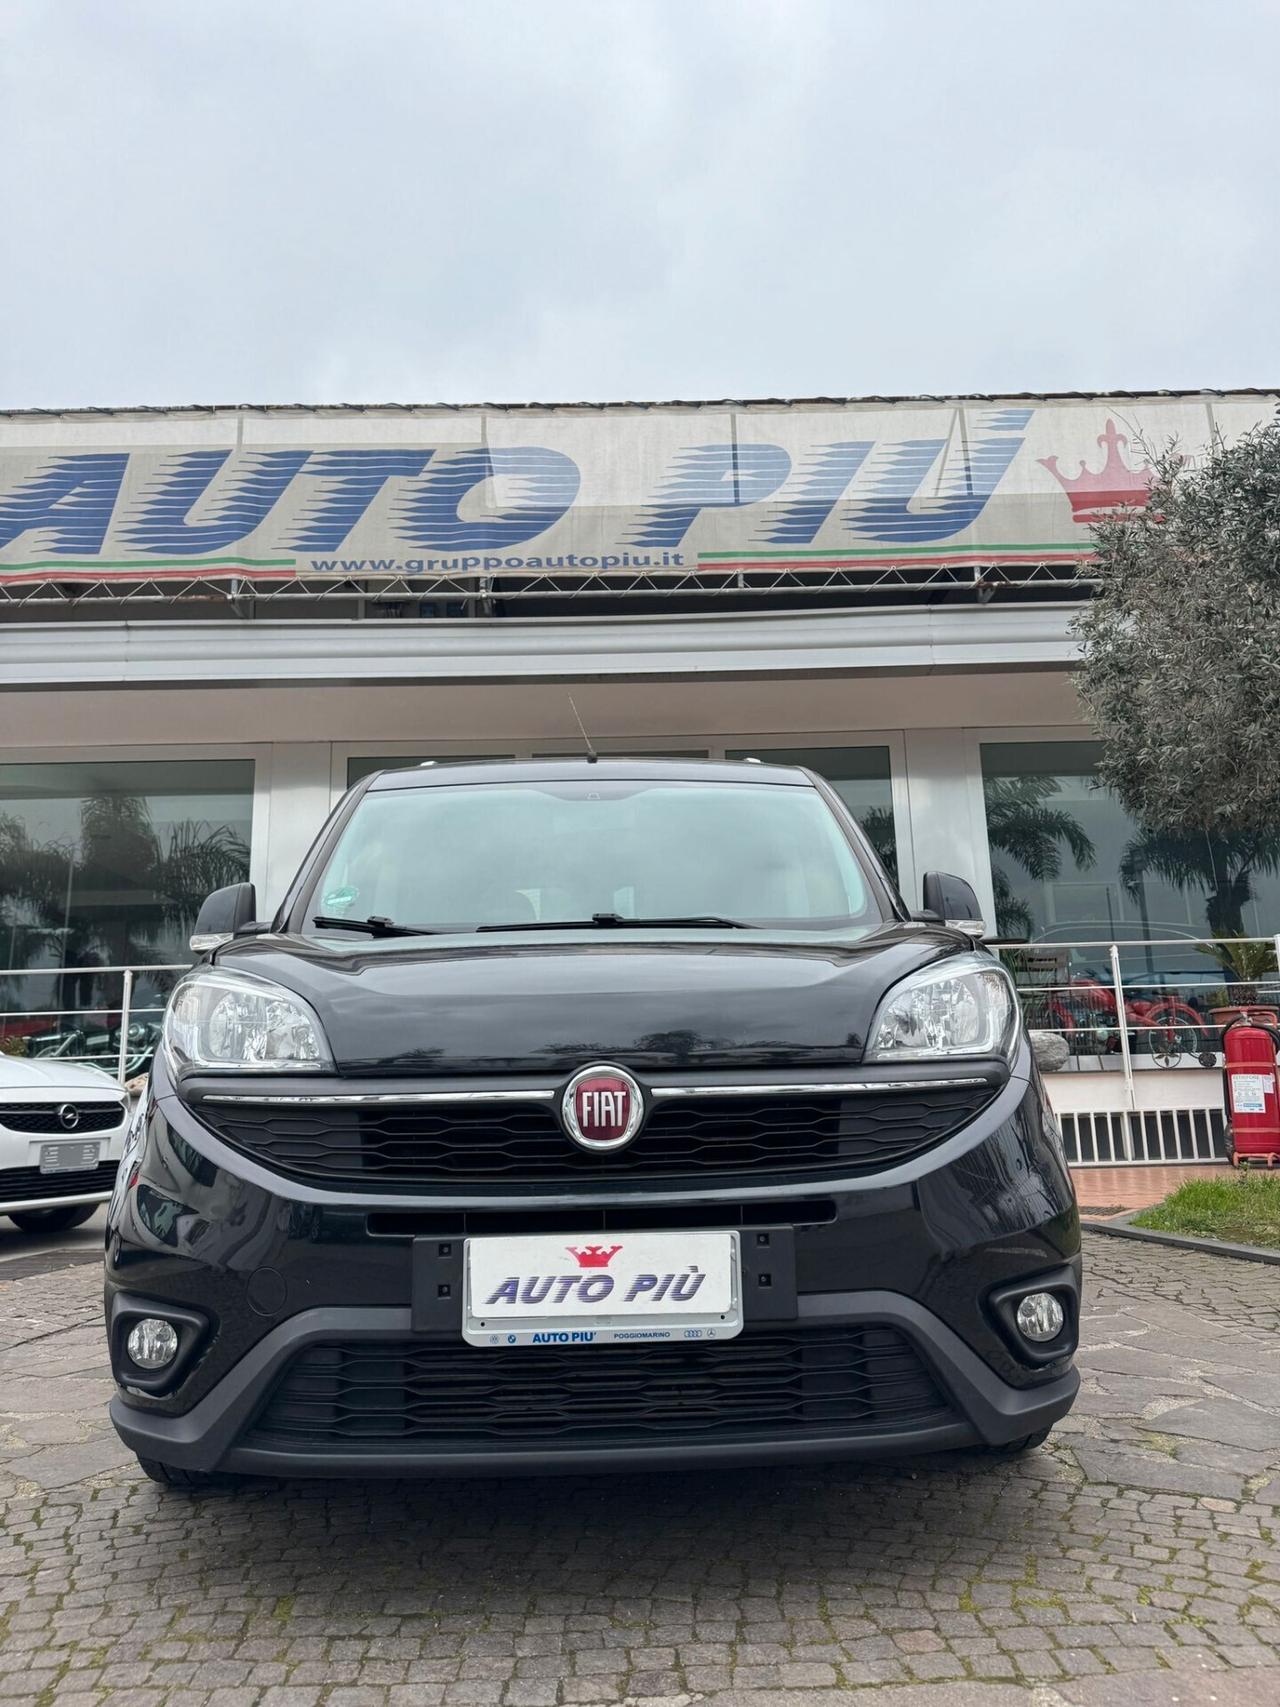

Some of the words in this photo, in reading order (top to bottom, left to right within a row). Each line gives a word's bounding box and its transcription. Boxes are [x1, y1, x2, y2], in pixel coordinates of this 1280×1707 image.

[0, 446, 581, 555] AUTO
[311, 552, 684, 572] www.gruppoautopiu.it
[582, 1091, 627, 1128] FIAT
[485, 1274, 615, 1305] AUTO
[623, 1265, 706, 1303] PIÙ
[532, 1332, 569, 1344] AUTO
[571, 1331, 598, 1343] PIU'
[613, 1331, 671, 1340] POGGIOMARINO
